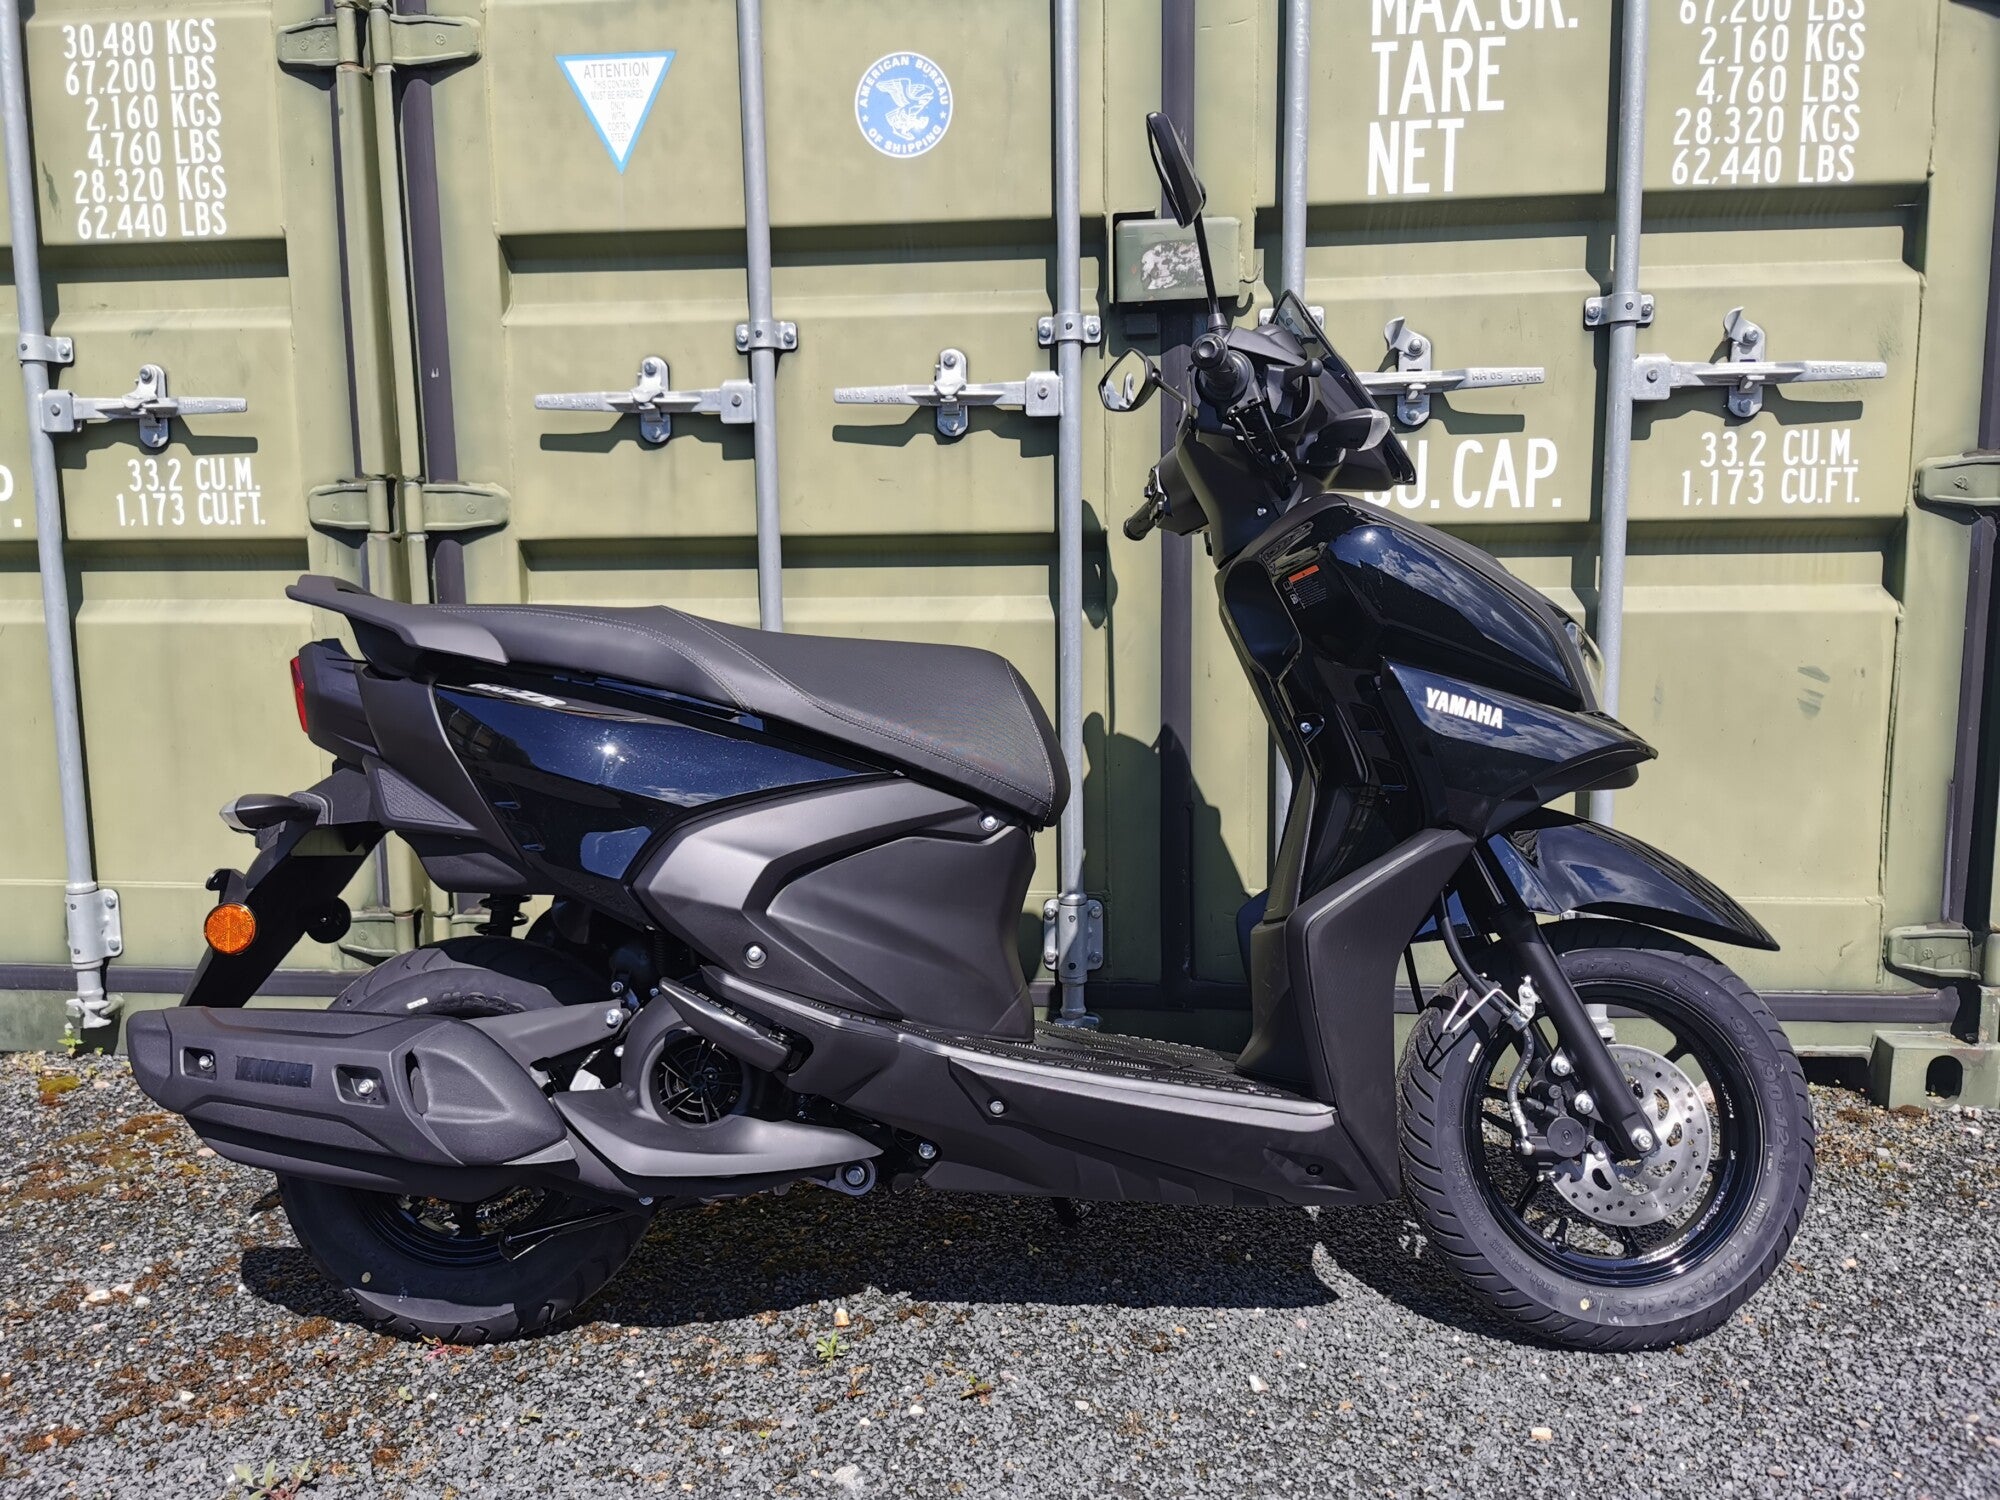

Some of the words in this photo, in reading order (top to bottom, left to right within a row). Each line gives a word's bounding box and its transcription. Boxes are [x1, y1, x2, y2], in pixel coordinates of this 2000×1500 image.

[1808, 0, 1865, 21] LBS
[63, 21, 153, 59] 30,480
[166, 18, 217, 55] KGS
[1699, 24, 1790, 65] 2,160
[1805, 22, 1866, 62] KGS
[65, 58, 156, 96] 67,200
[169, 56, 217, 91] LBS
[584, 61, 649, 78] ATTENTION
[859, 56, 910, 108] AMERICAN
[915, 59, 949, 105] BUREAU
[1371, 36, 1507, 116] TARE
[1696, 65, 1787, 105] 4,760
[1802, 63, 1860, 103] LBS
[85, 94, 158, 132] 2,160
[171, 92, 222, 128] KGS
[1673, 105, 1784, 146] 28,320
[1800, 104, 1861, 143] KGS
[88, 131, 161, 168] 4,760
[174, 128, 222, 164] LBS
[868, 128, 884, 143] OF
[884, 125, 943, 153] SHIPPING
[1367, 118, 1465, 196] NET
[73, 167, 164, 204] 28,320
[176, 165, 227, 201] KGS
[1671, 146, 1782, 185] 62,440
[1798, 145, 1855, 183] LBS
[77, 203, 167, 240] 62,440
[179, 201, 228, 237] LBS
[1700, 430, 1767, 468] 33.2
[1783, 428, 1859, 466] CU.M.
[127, 458, 183, 492] 33.2
[195, 457, 261, 491] CU.M.
[1364, 440, 1440, 509] U.
[1453, 438, 1562, 509] CAP.
[1682, 468, 1765, 506] 1,173
[1781, 467, 1861, 504] CU.FT.
[116, 493, 186, 527] 1,173
[198, 491, 266, 525] CU.FT.
[1426, 687, 1503, 729] YAMAHA
